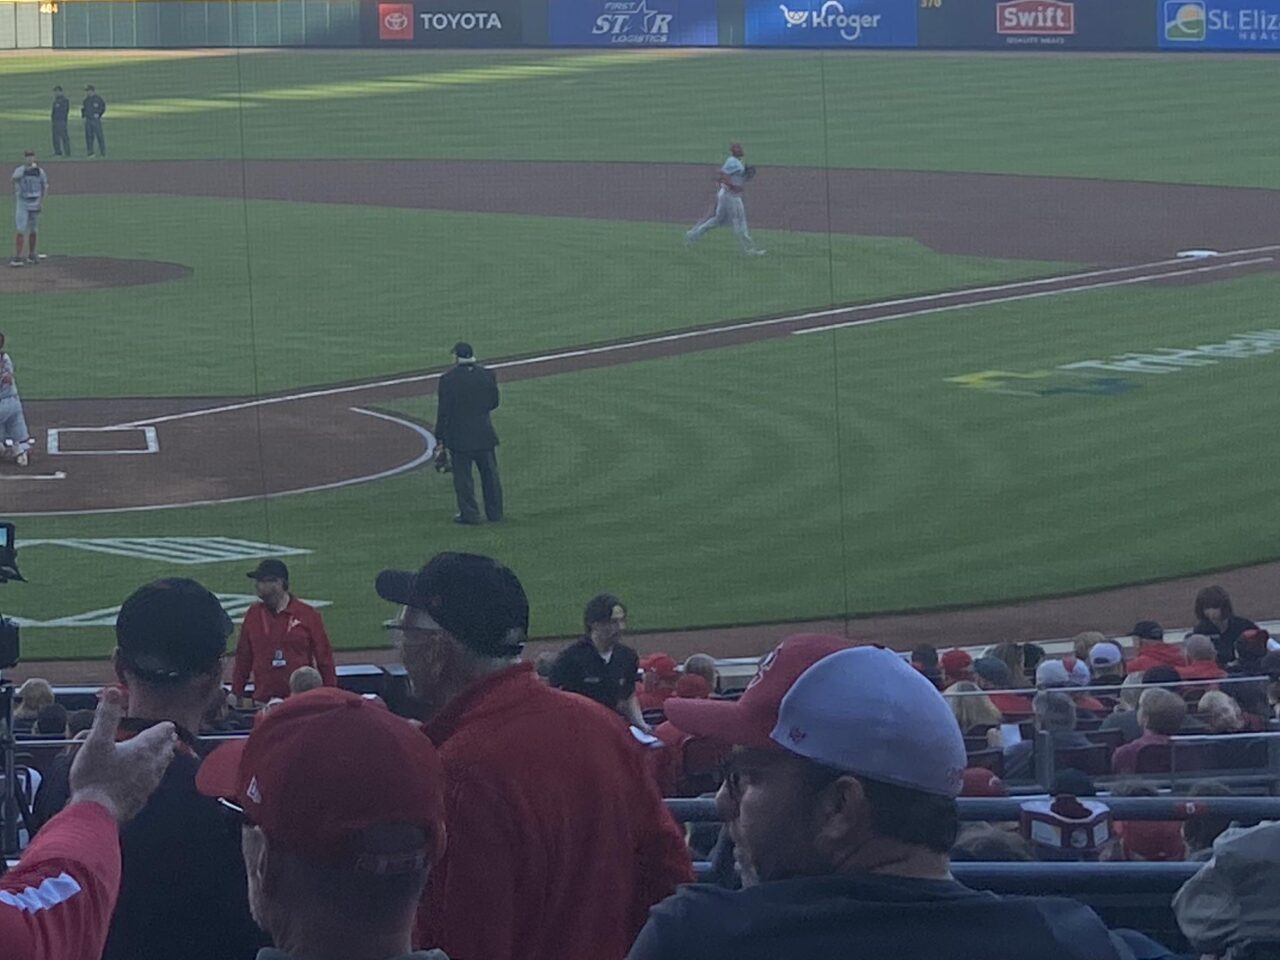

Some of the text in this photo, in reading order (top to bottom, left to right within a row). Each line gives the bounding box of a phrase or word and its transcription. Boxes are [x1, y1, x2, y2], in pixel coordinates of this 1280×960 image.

[604, 1, 637, 10] FIRST
[420, 13, 502, 30] TOYOTA
[811, 0, 881, 40] Kroger
[1003, 6, 1065, 28] Swift
[1207, 9, 1235, 31] St.
